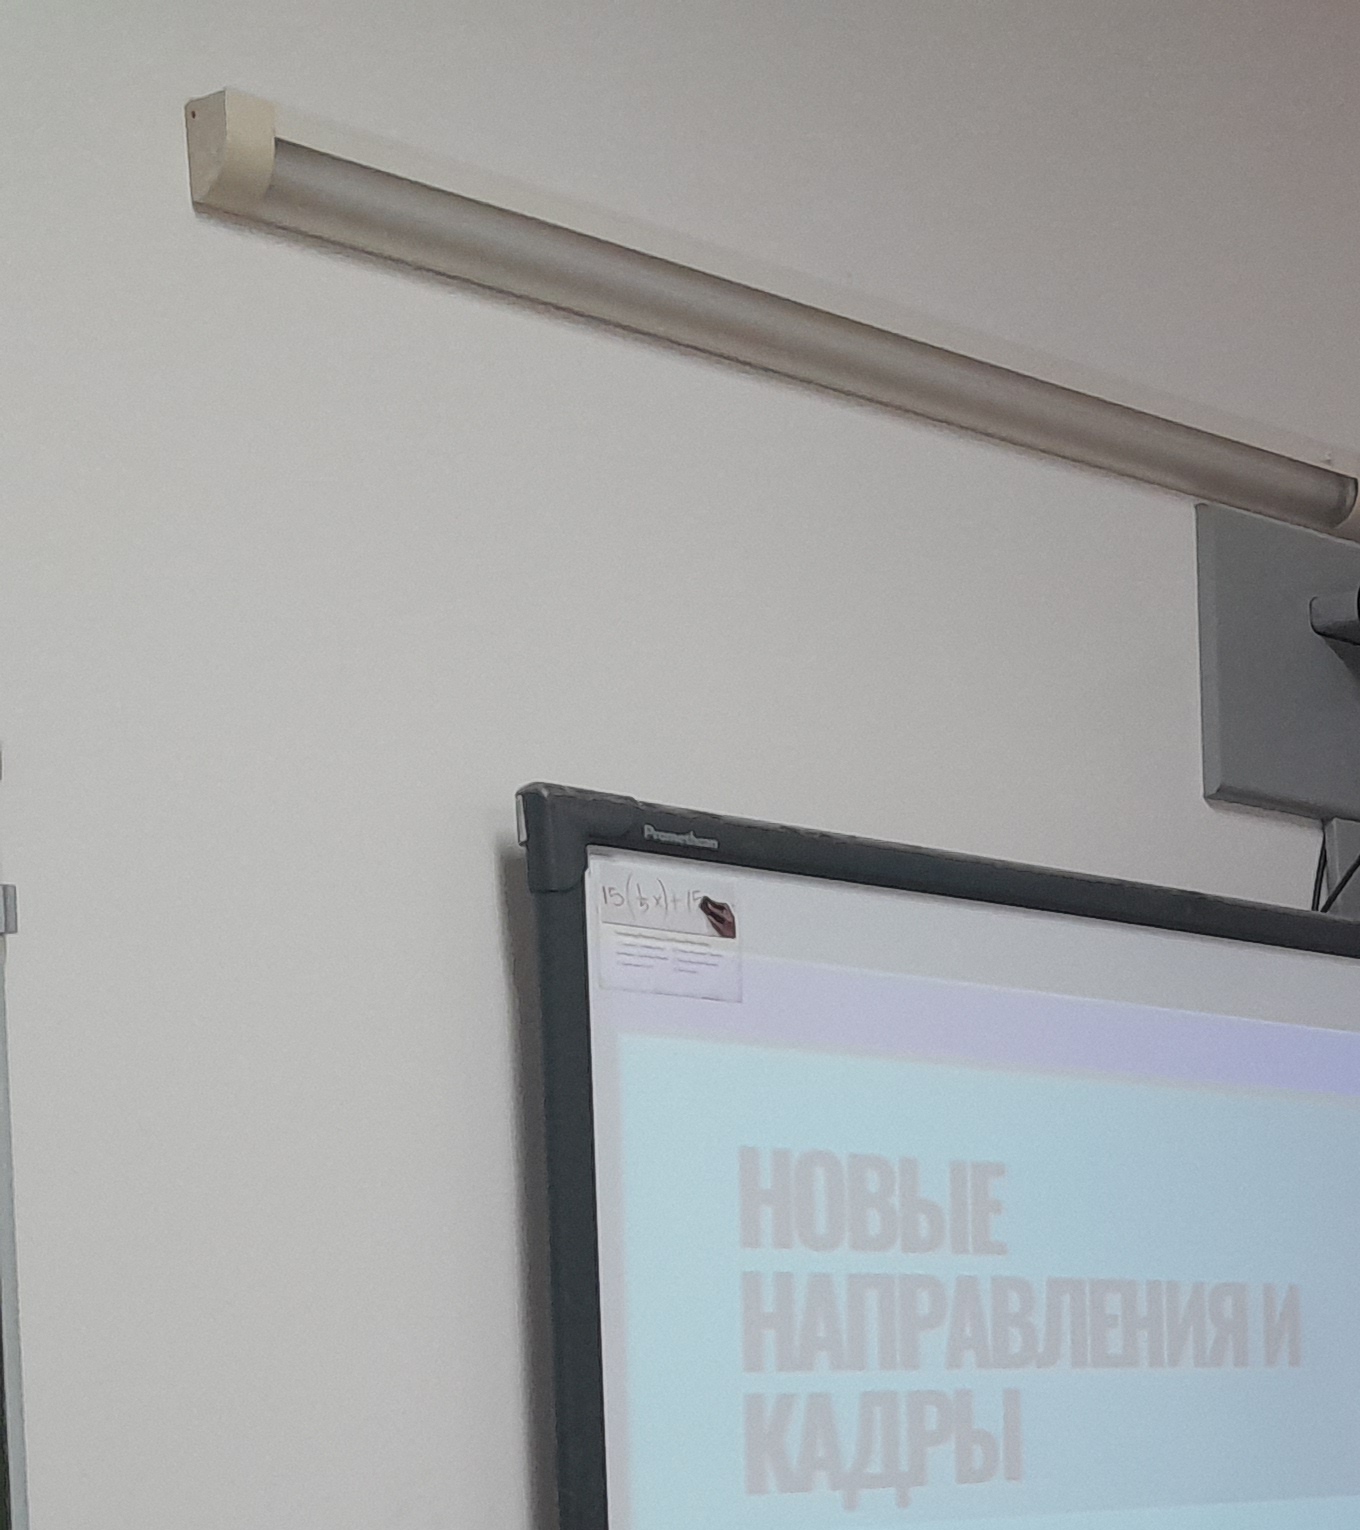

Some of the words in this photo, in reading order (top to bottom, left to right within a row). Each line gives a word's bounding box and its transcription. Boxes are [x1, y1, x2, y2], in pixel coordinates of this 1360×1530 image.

[738, 1146, 1008, 1256] НОВЫЕ
[741, 1270, 1250, 1373] НАПРАВЛЕНИЯ
[1262, 1281, 1302, 1369] И
[743, 1387, 1024, 1512] КАДРЫ
